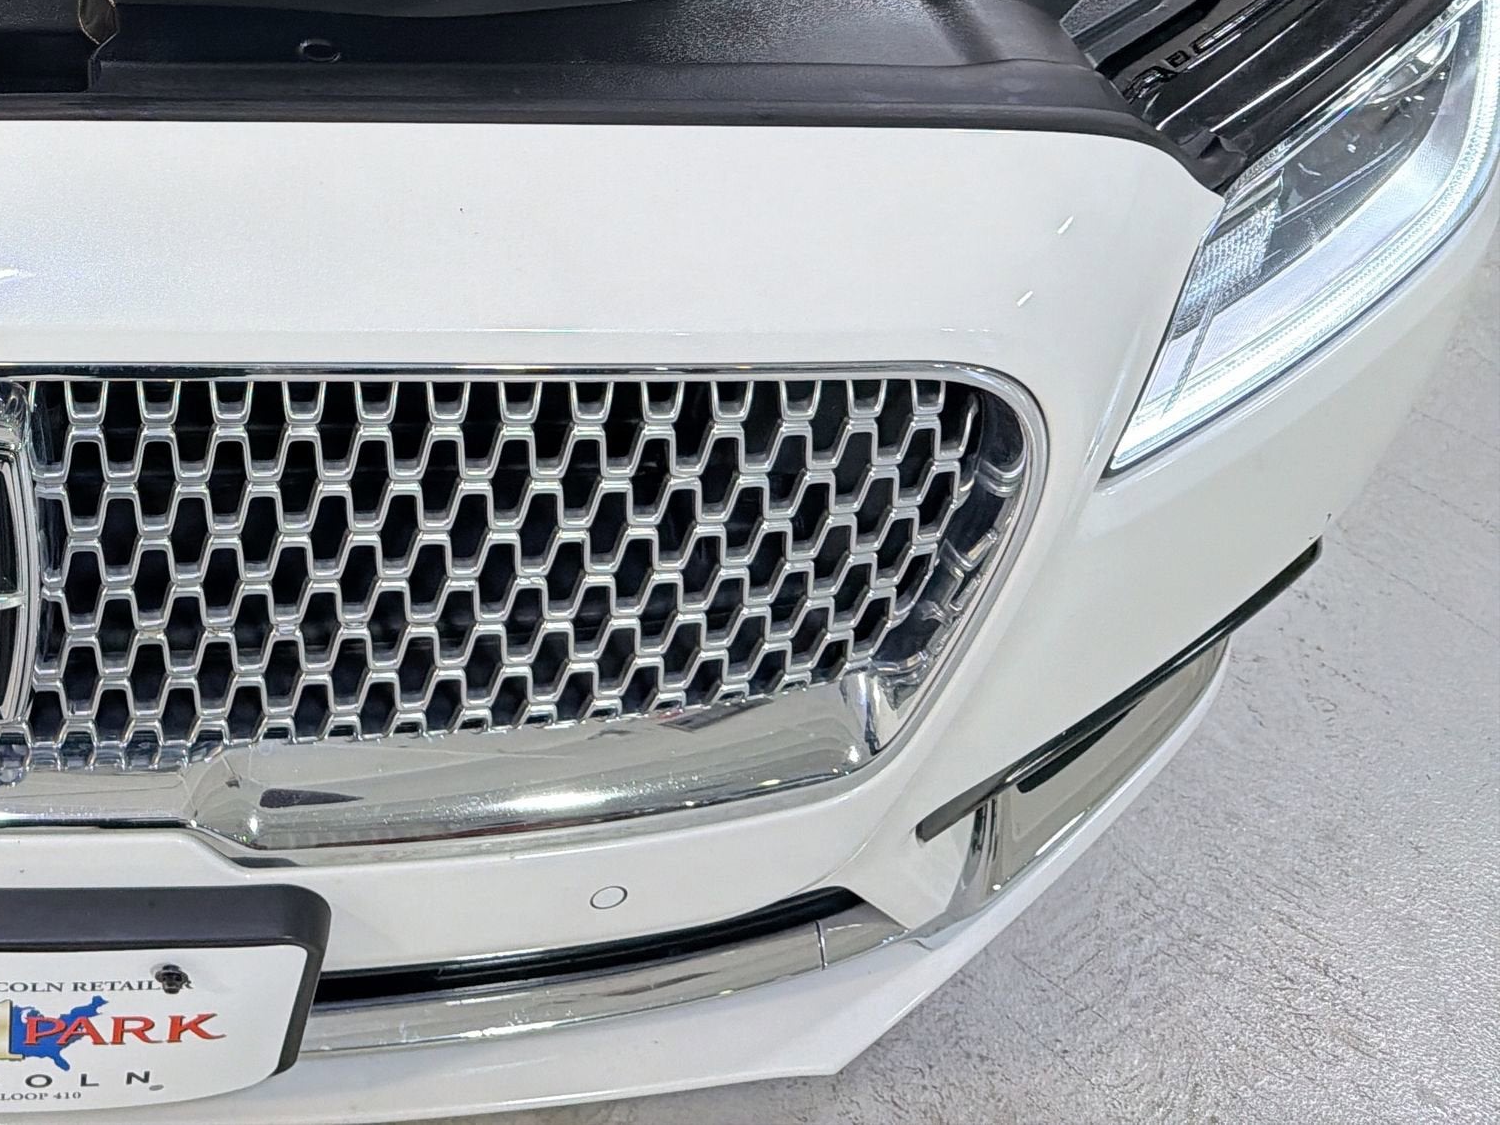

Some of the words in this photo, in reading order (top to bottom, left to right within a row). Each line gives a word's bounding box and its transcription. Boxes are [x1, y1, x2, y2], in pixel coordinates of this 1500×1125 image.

[72, 979, 194, 993] RETAILR
[22, 1012, 227, 1047] PARK
[0, 1091, 49, 1101] LOOP
[53, 1090, 82, 1100] 410
